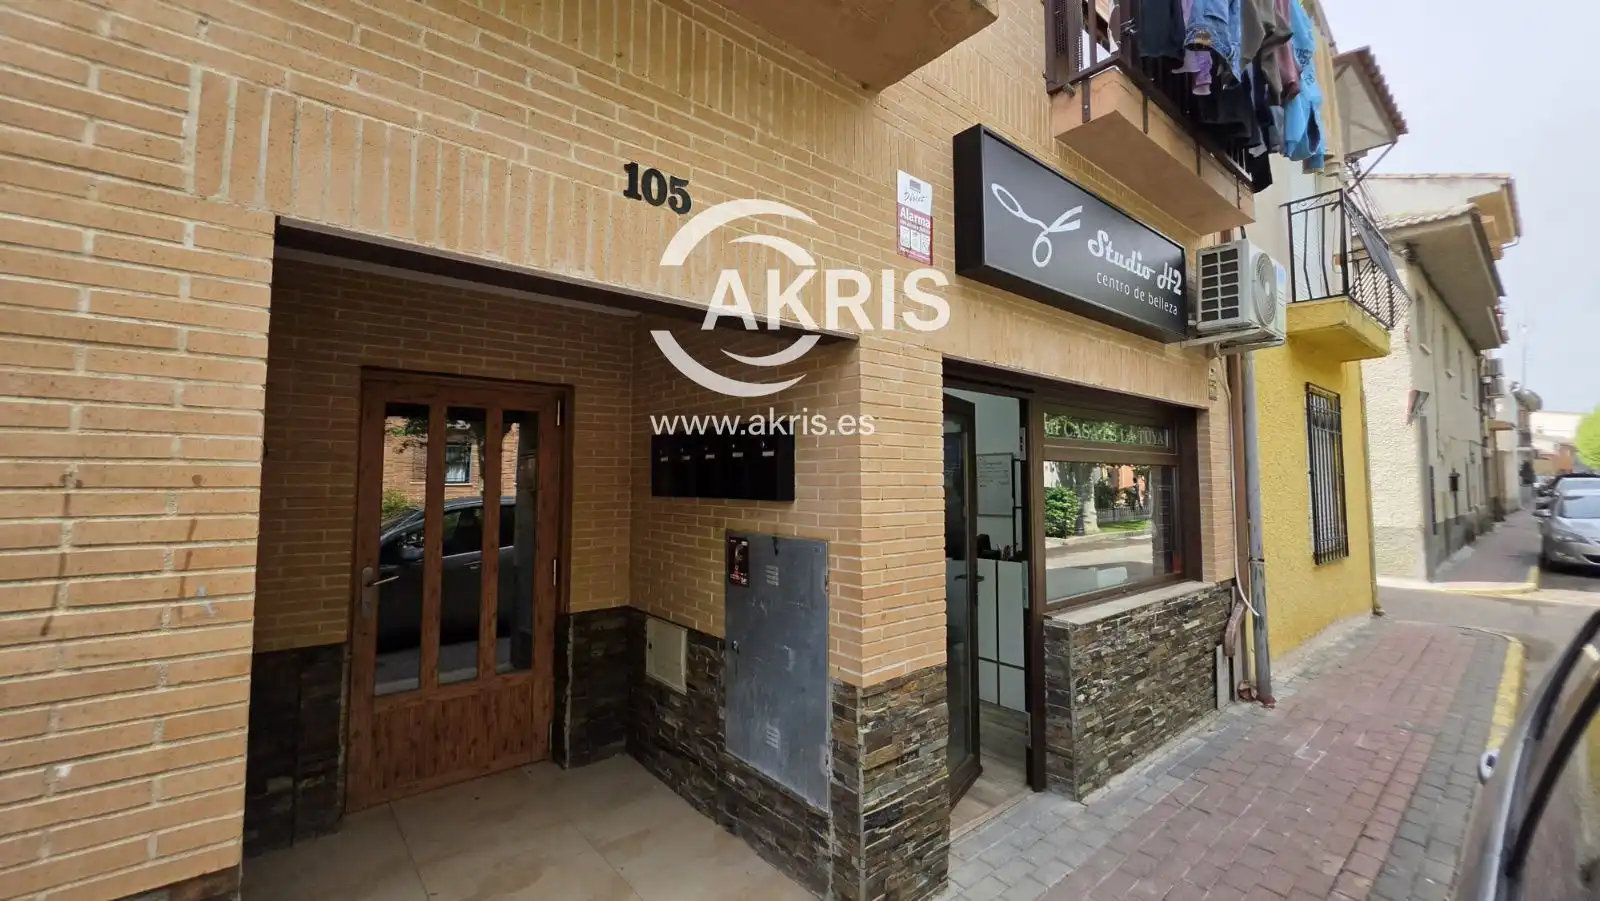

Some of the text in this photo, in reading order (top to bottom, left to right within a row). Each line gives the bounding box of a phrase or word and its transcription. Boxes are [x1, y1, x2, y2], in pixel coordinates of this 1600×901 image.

[623, 161, 692, 214] 105
[900, 206, 931, 229] Alarma
[1087, 229, 1156, 280] Studio
[1096, 271, 1178, 316] centro de belleza
